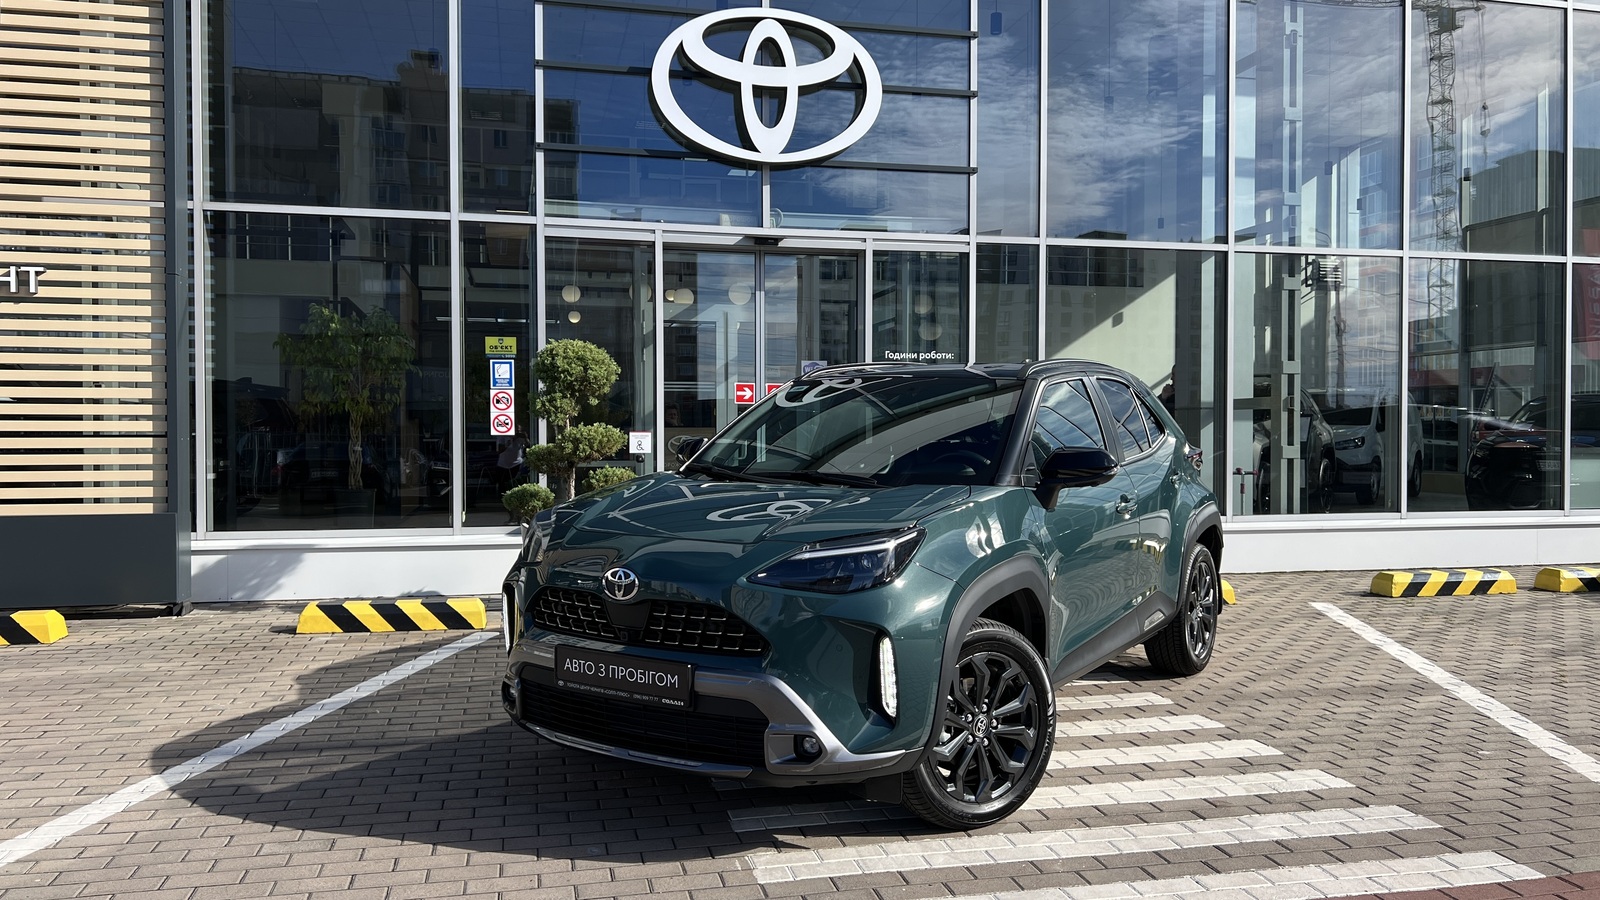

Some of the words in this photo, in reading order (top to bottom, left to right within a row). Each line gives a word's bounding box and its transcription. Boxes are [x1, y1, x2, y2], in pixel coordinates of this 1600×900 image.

[885, 350, 918, 361] Години
[919, 350, 955, 361] роботи:
[564, 658, 595, 675] АВТО
[609, 665, 678, 688] ПРОБІГОМ
